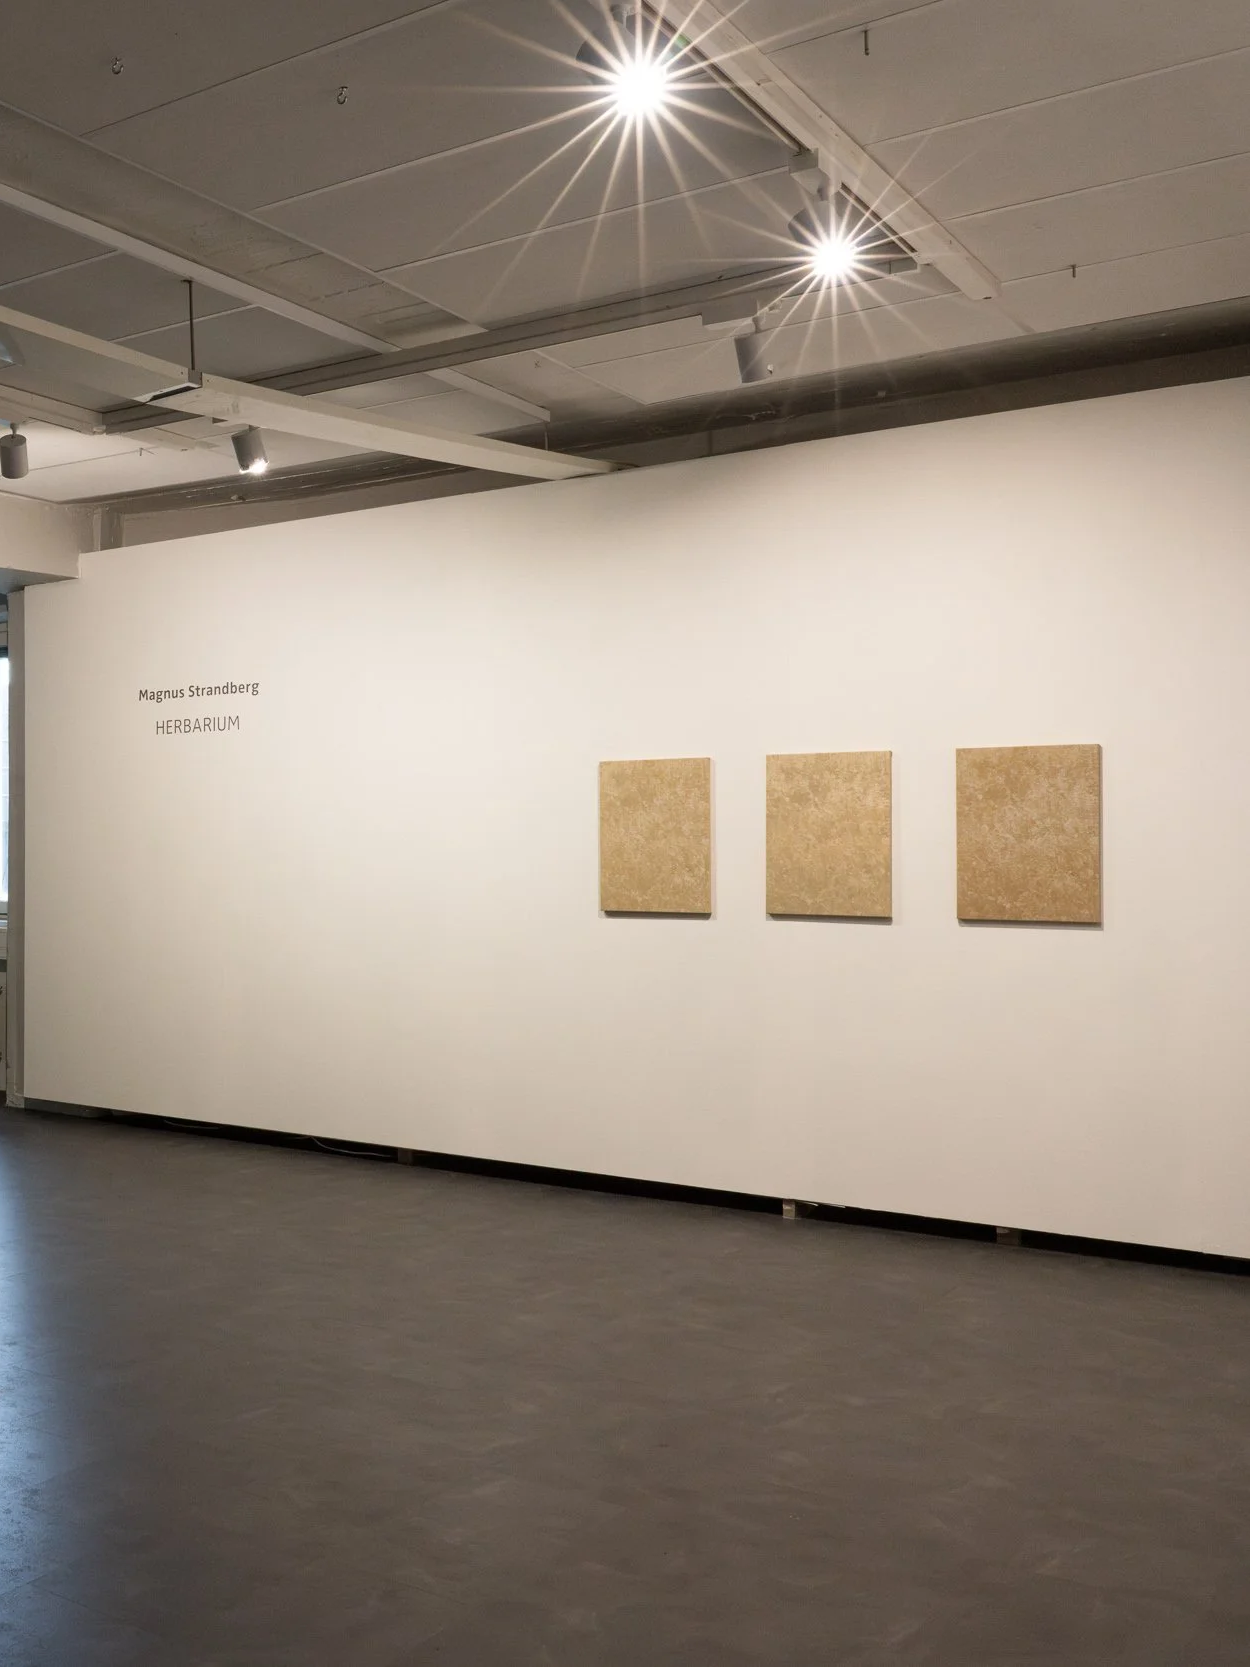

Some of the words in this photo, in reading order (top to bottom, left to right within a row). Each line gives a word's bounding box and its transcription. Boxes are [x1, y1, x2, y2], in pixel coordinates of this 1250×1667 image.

[138, 688, 185, 703] Magnus
[188, 681, 260, 697] Strandberg
[155, 715, 240, 735] HERBARIUM
